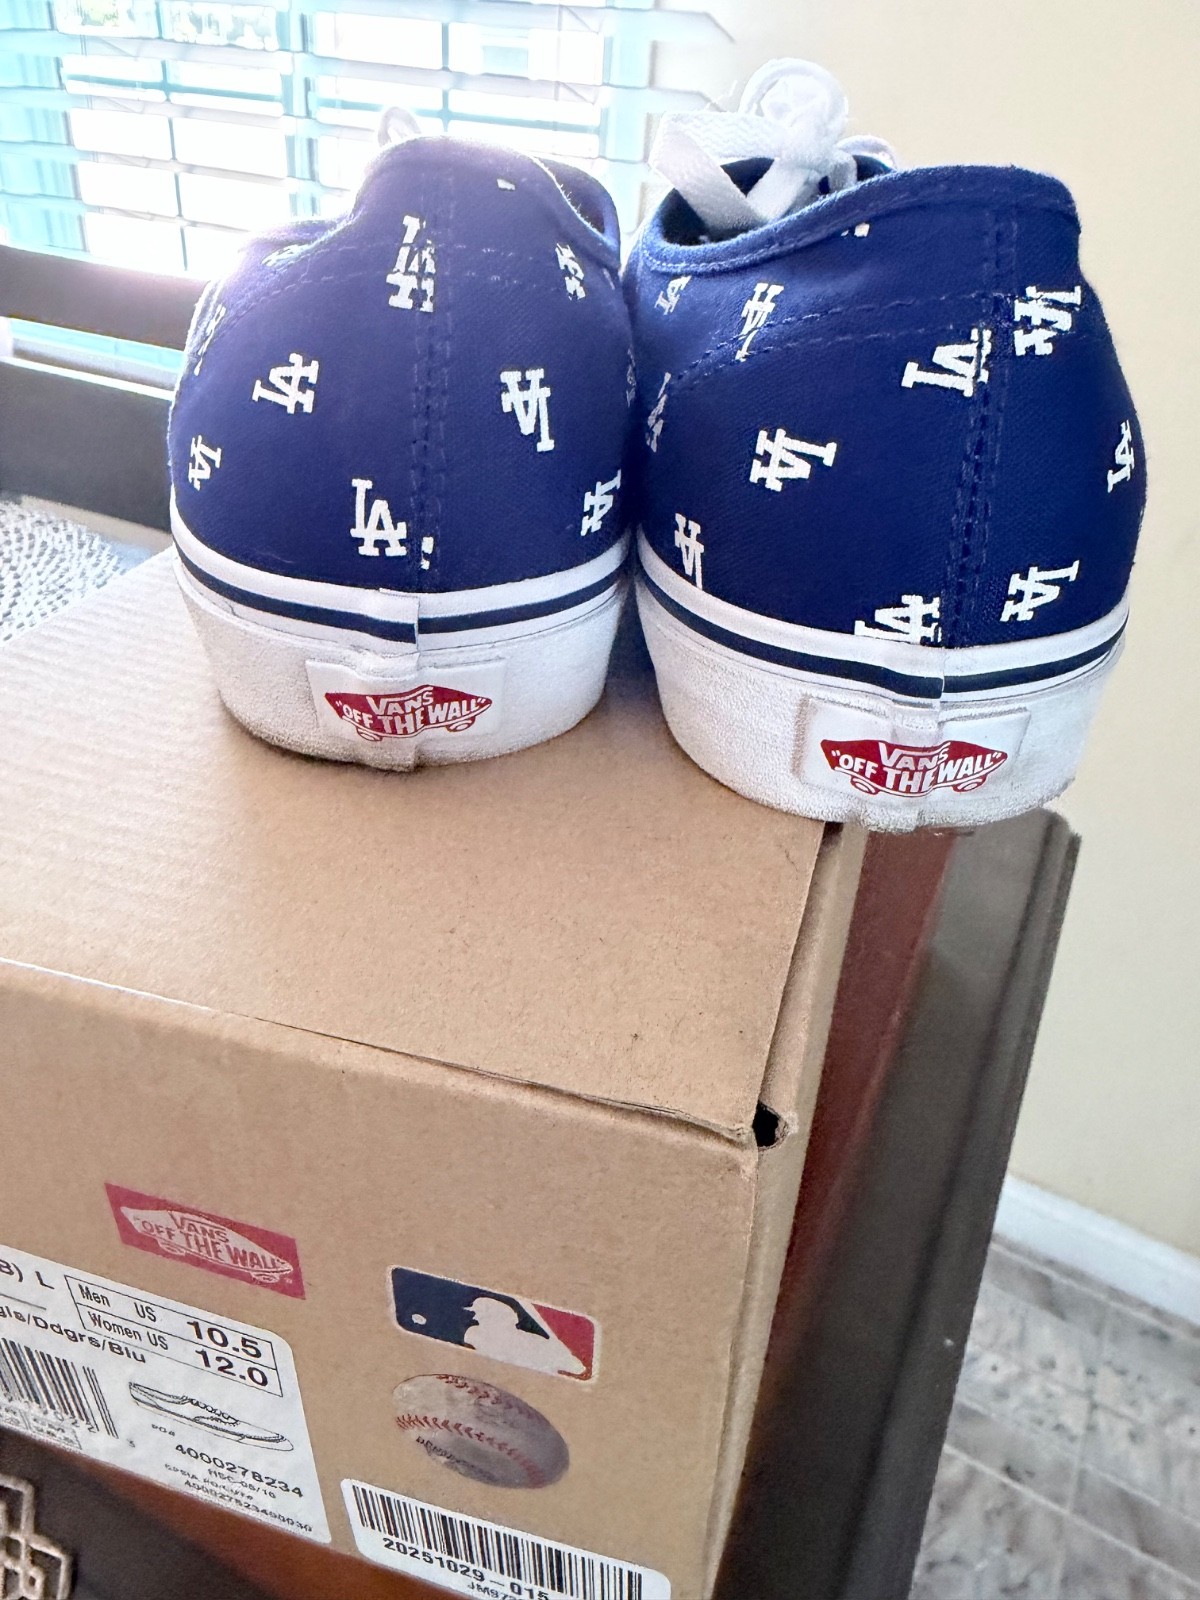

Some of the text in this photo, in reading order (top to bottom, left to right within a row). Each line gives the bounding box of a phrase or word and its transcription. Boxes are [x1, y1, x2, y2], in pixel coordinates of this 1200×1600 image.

[252, 352, 319, 413] LA
[902, 328, 992, 397] LA
[501, 368, 554, 452] LA
[188, 434, 222, 490] LA
[750, 427, 837, 492] LA
[1107, 420, 1134, 493] LA
[350, 478, 407, 557] LA
[1000, 560, 1080, 622] LA
[366, 686, 434, 716] VANS
[377, 707, 425, 735] THE
[878, 742, 951, 770] VANS
[883, 767, 937, 793] THE
[168, 1211, 230, 1244] VANS
[180, 1231, 225, 1262] THE
[35, 1271, 55, 1290] L
[78, 1284, 262, 1359] Men US 10.5
[88, 1311, 268, 1387] Women US 12.0
[176, 1444, 304, 1498] 4000278234
